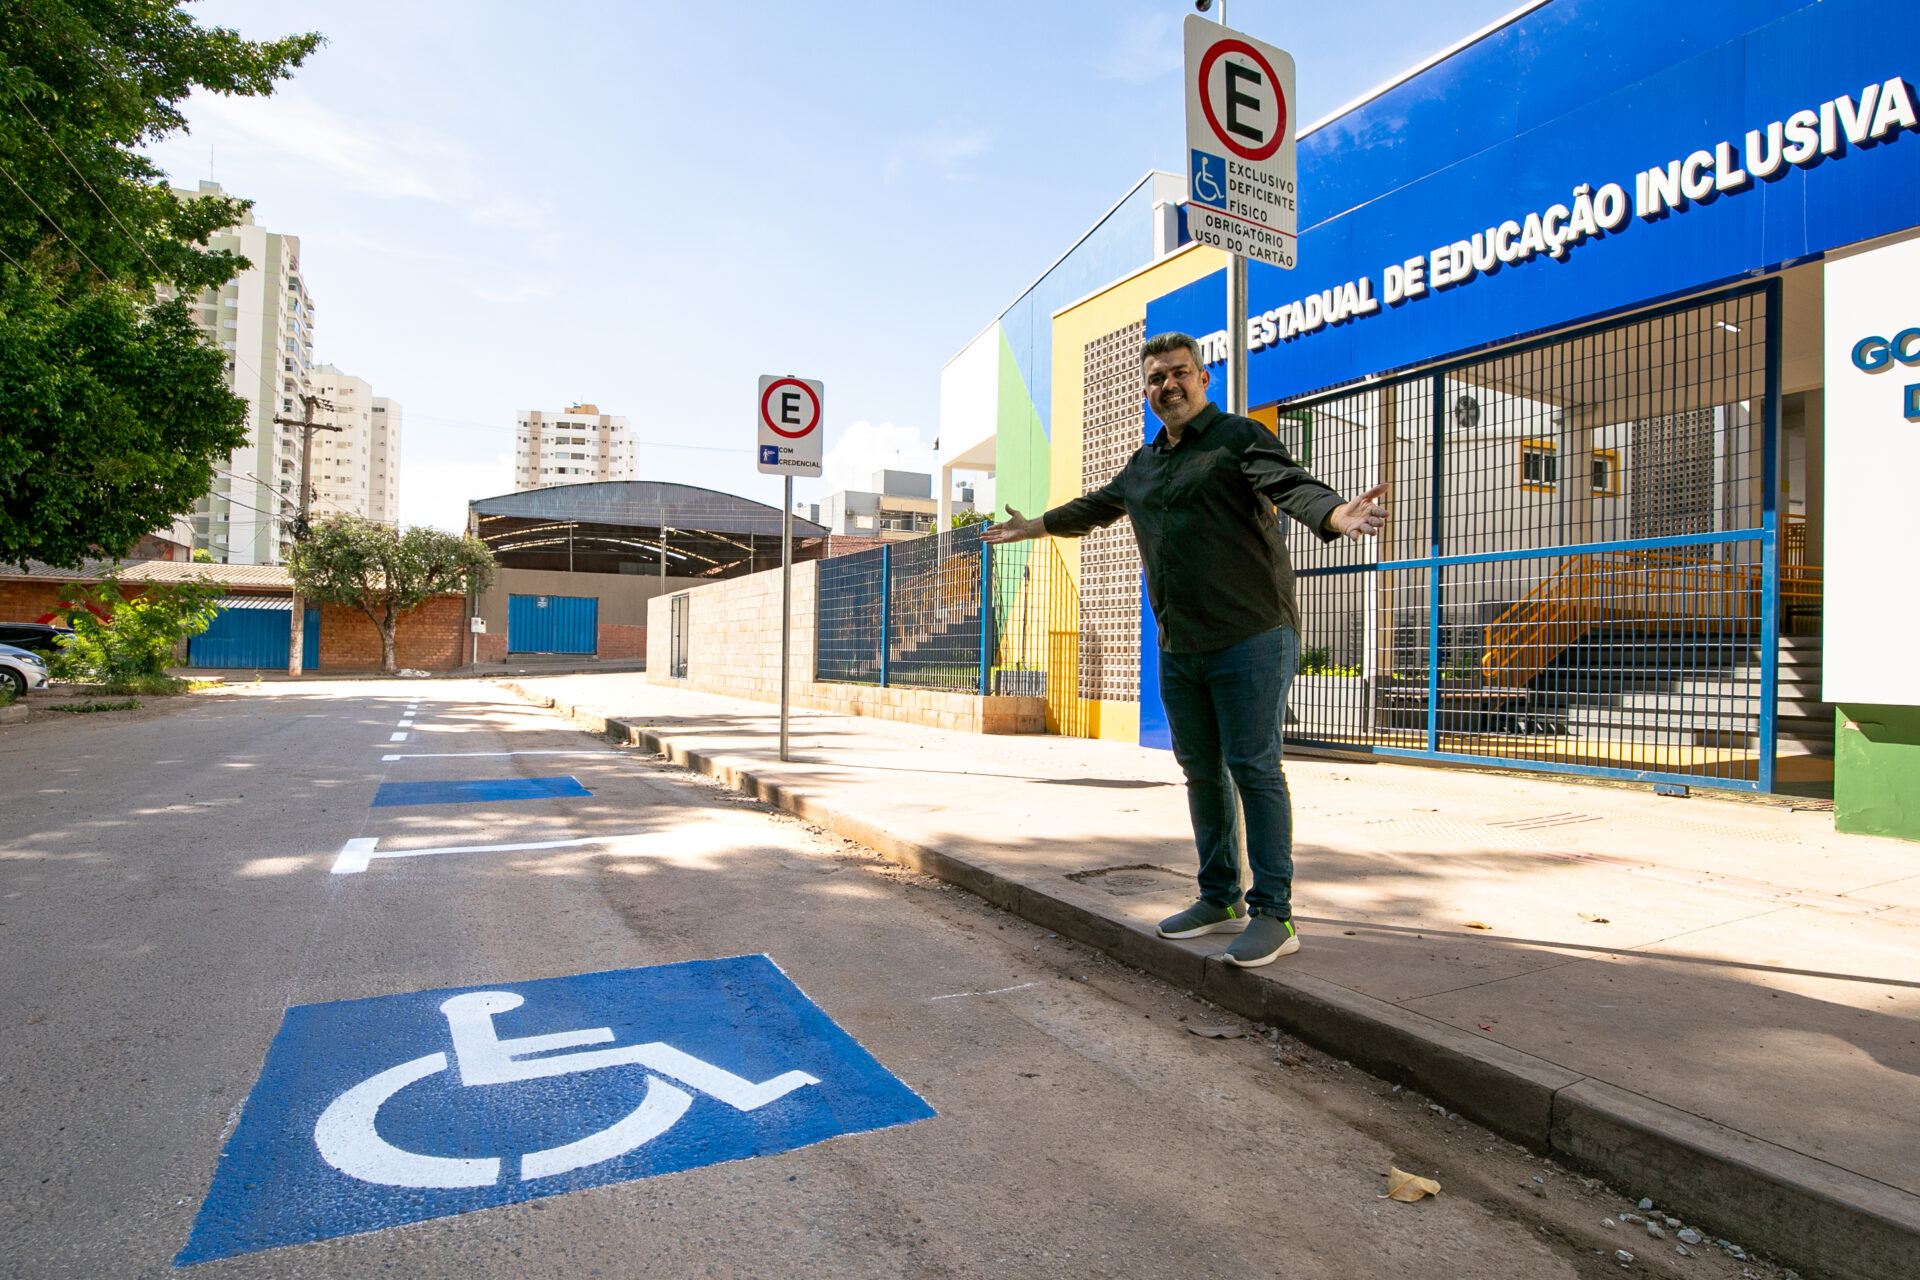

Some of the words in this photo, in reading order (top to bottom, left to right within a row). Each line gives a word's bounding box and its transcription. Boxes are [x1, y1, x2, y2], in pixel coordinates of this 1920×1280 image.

[1225, 60, 1263, 143] E
[1229, 161, 1294, 194] EXCLUSIVO
[1229, 178, 1295, 212] DEFICIENTE
[1229, 199, 1268, 223] FÍSICO
[1247, 276, 1378, 350] ESTADUAL
[1384, 255, 1425, 303] DE
[1430, 182, 1626, 288] EDUCAÇÃO
[1636, 76, 1918, 217] INCLUSIVA
[1205, 214, 1283, 249] OBRIGATÓRIO
[1195, 229, 1220, 246] USO
[1227, 237, 1242, 252] DO
[1249, 244, 1293, 268] CARTÃO
[781, 392, 801, 425] E
[778, 458, 821, 469] CREDENCIAL
[779, 447, 794, 455] COM
